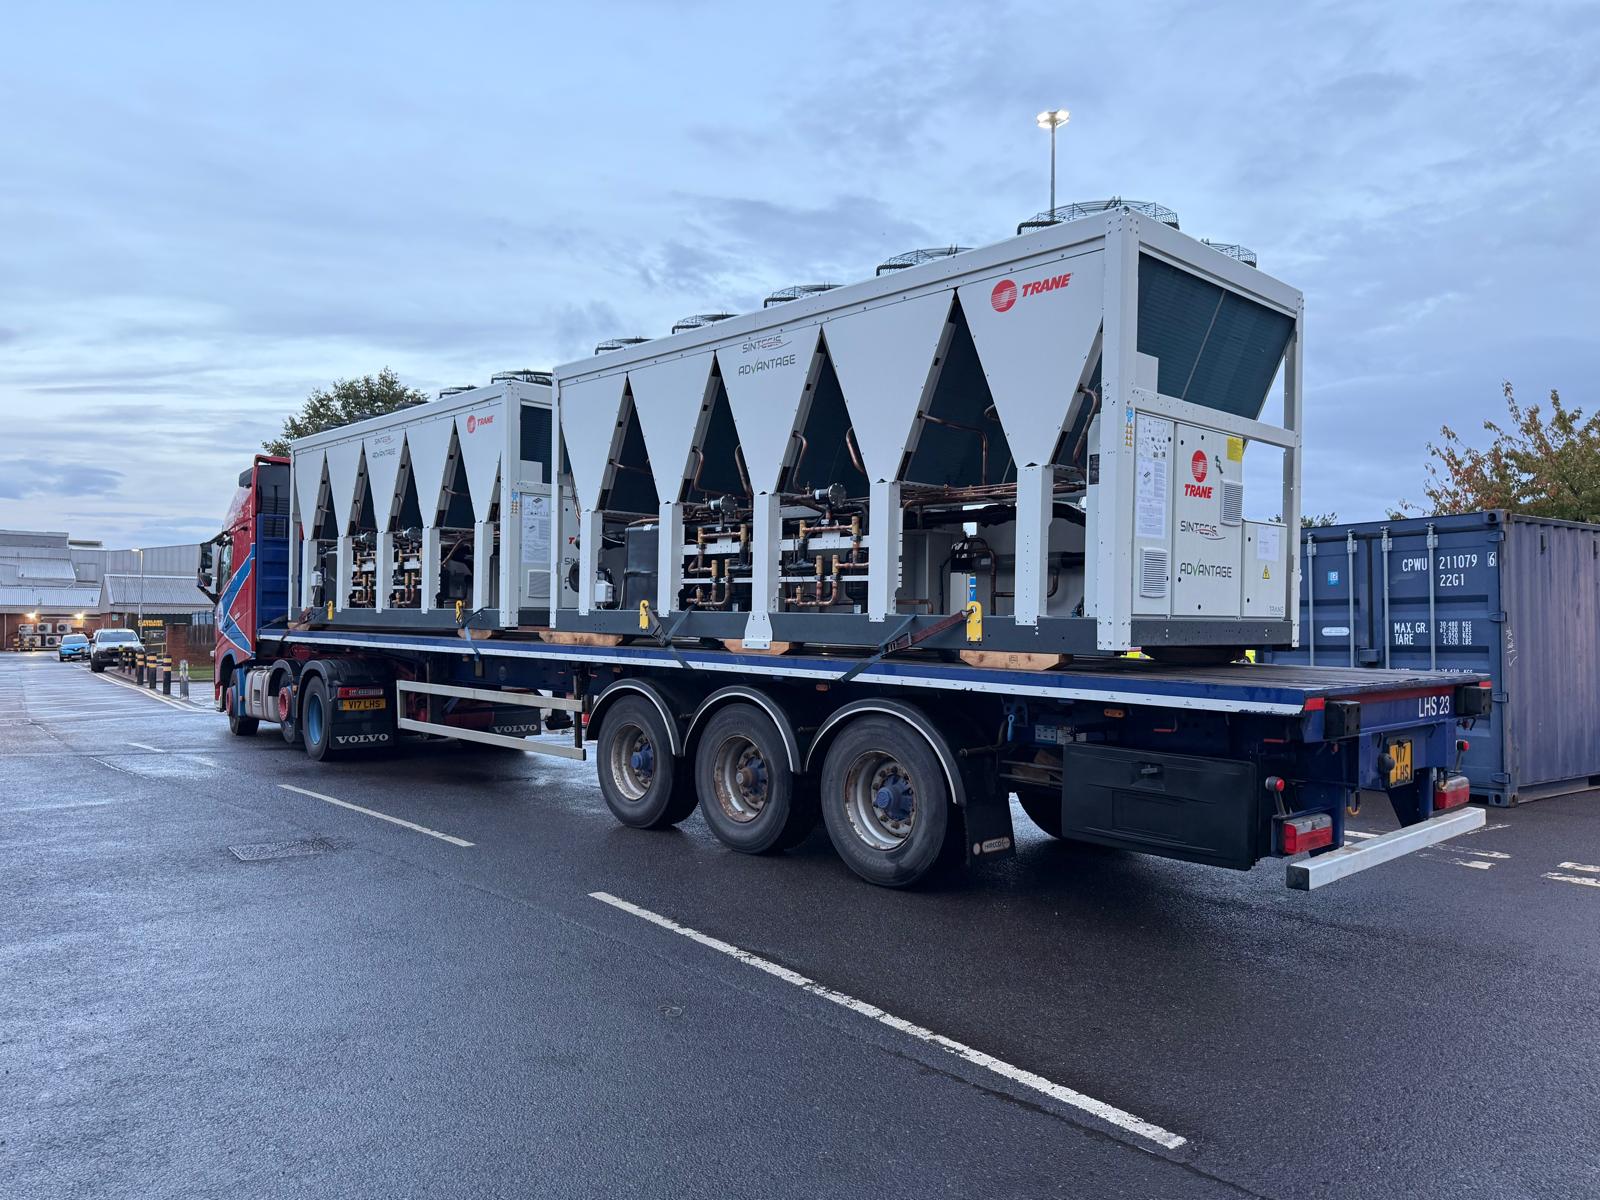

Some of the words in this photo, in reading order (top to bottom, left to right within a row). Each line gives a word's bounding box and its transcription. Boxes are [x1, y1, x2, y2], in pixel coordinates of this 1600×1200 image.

[1022, 273, 1071, 297] TRANE
[738, 354, 796, 376] ADVANTAGE
[1184, 484, 1212, 499] TRANE
[1180, 559, 1232, 578] ADVANTAGE
[1402, 558, 1428, 572] CPWU
[1439, 554, 1478, 570] 211079
[1488, 552, 1496, 567] 6
[1440, 574, 1464, 586] 22G1
[1395, 633, 1414, 645] TARE
[348, 700, 362, 709] V17
[363, 700, 381, 709] LHS
[1418, 696, 1437, 718] LHS
[1439, 695, 1450, 714] 23
[493, 724, 538, 734] VOLVO
[336, 734, 389, 744] VOLVO
